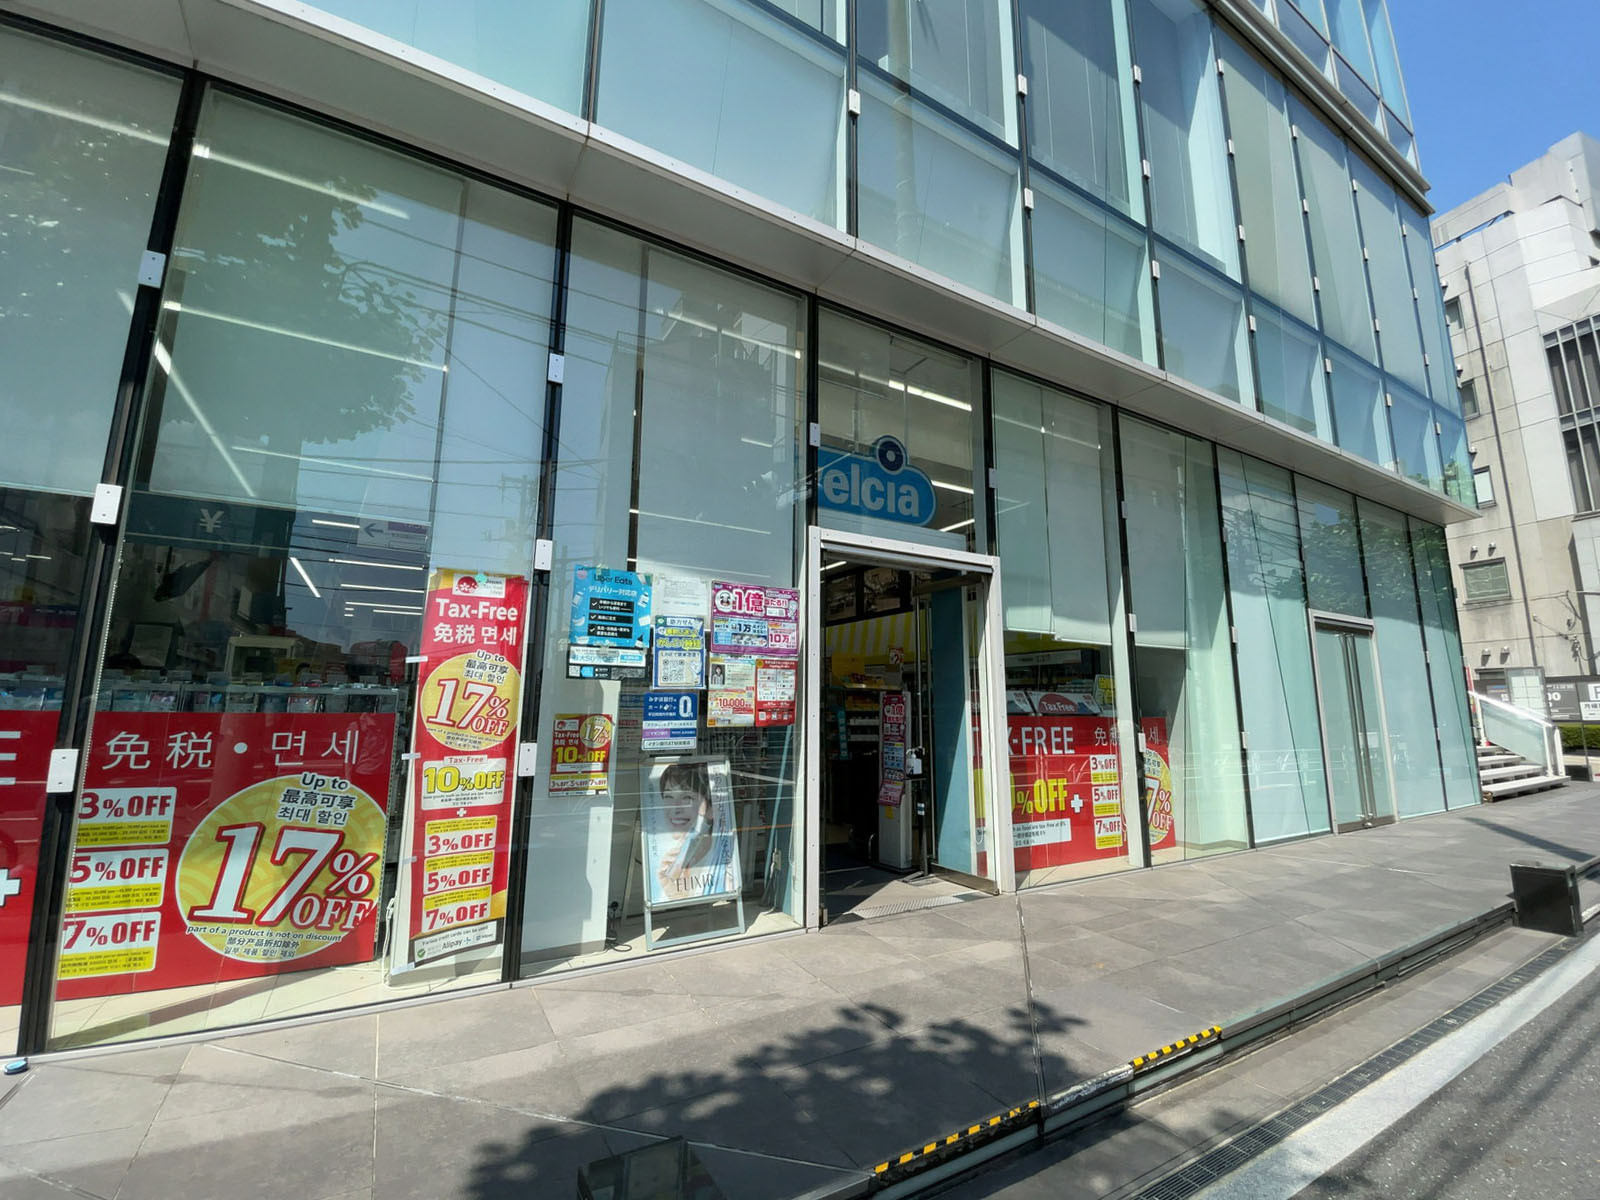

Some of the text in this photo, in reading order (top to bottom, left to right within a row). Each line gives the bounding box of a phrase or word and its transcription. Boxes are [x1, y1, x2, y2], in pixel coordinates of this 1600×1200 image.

[819, 463, 920, 518] elcia
[435, 598, 519, 621] Tax-Free
[433, 622, 518, 646] 免税 면세
[477, 649, 505, 663] Up to
[427, 679, 510, 730] 17%
[471, 717, 509, 737] OFF
[449, 755, 484, 764] Tax-Free
[301, 772, 350, 791] Up to
[424, 766, 505, 793] 10%OFF
[78, 791, 172, 820] 3%OFF
[281, 788, 357, 811] 最高可享
[277, 806, 348, 827] 최대 할인
[1152, 811, 1173, 830] OFF
[427, 833, 494, 854] 3%OFF
[69, 855, 165, 884] 5%OFF
[188, 822, 379, 929] 17%
[427, 867, 490, 892] 5%OFF
[291, 896, 377, 931] OFF
[425, 902, 488, 931] 7%OFF
[62, 919, 156, 950] 7%OFF
[187, 926, 207, 935] part
[209, 926, 220, 934] of
[228, 929, 265, 937] product
[305, 933, 342, 942] discount
[441, 938, 463, 951] Alipay
